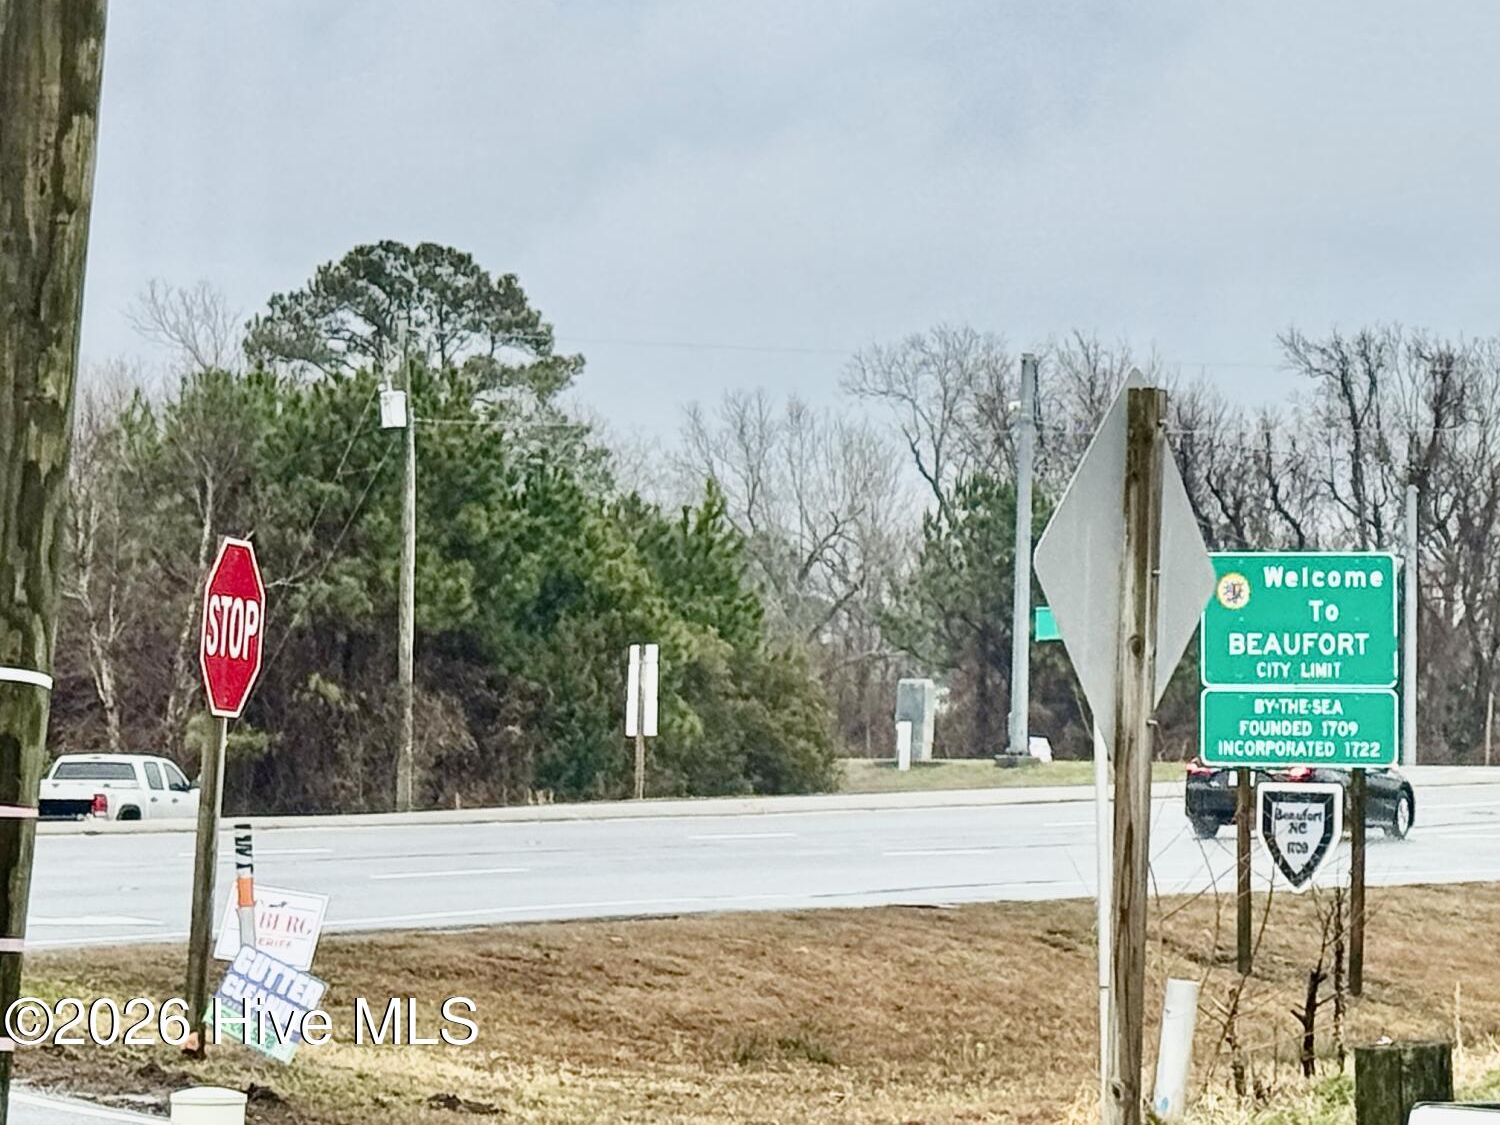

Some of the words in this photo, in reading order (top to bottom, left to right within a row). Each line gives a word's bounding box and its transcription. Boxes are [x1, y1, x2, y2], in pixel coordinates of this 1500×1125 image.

[1263, 565, 1384, 588] Welcome
[1308, 599, 1340, 623] To
[206, 594, 260, 661] STOP
[1228, 632, 1370, 656] BEAUFORT
[1256, 661, 1292, 679] CITY
[1300, 662, 1342, 679] LIMIT
[1239, 720, 1313, 737] FOUNDED
[1321, 721, 1359, 738] 1709
[1218, 740, 1336, 758] INCORPORATED
[1343, 741, 1381, 759] 1722
